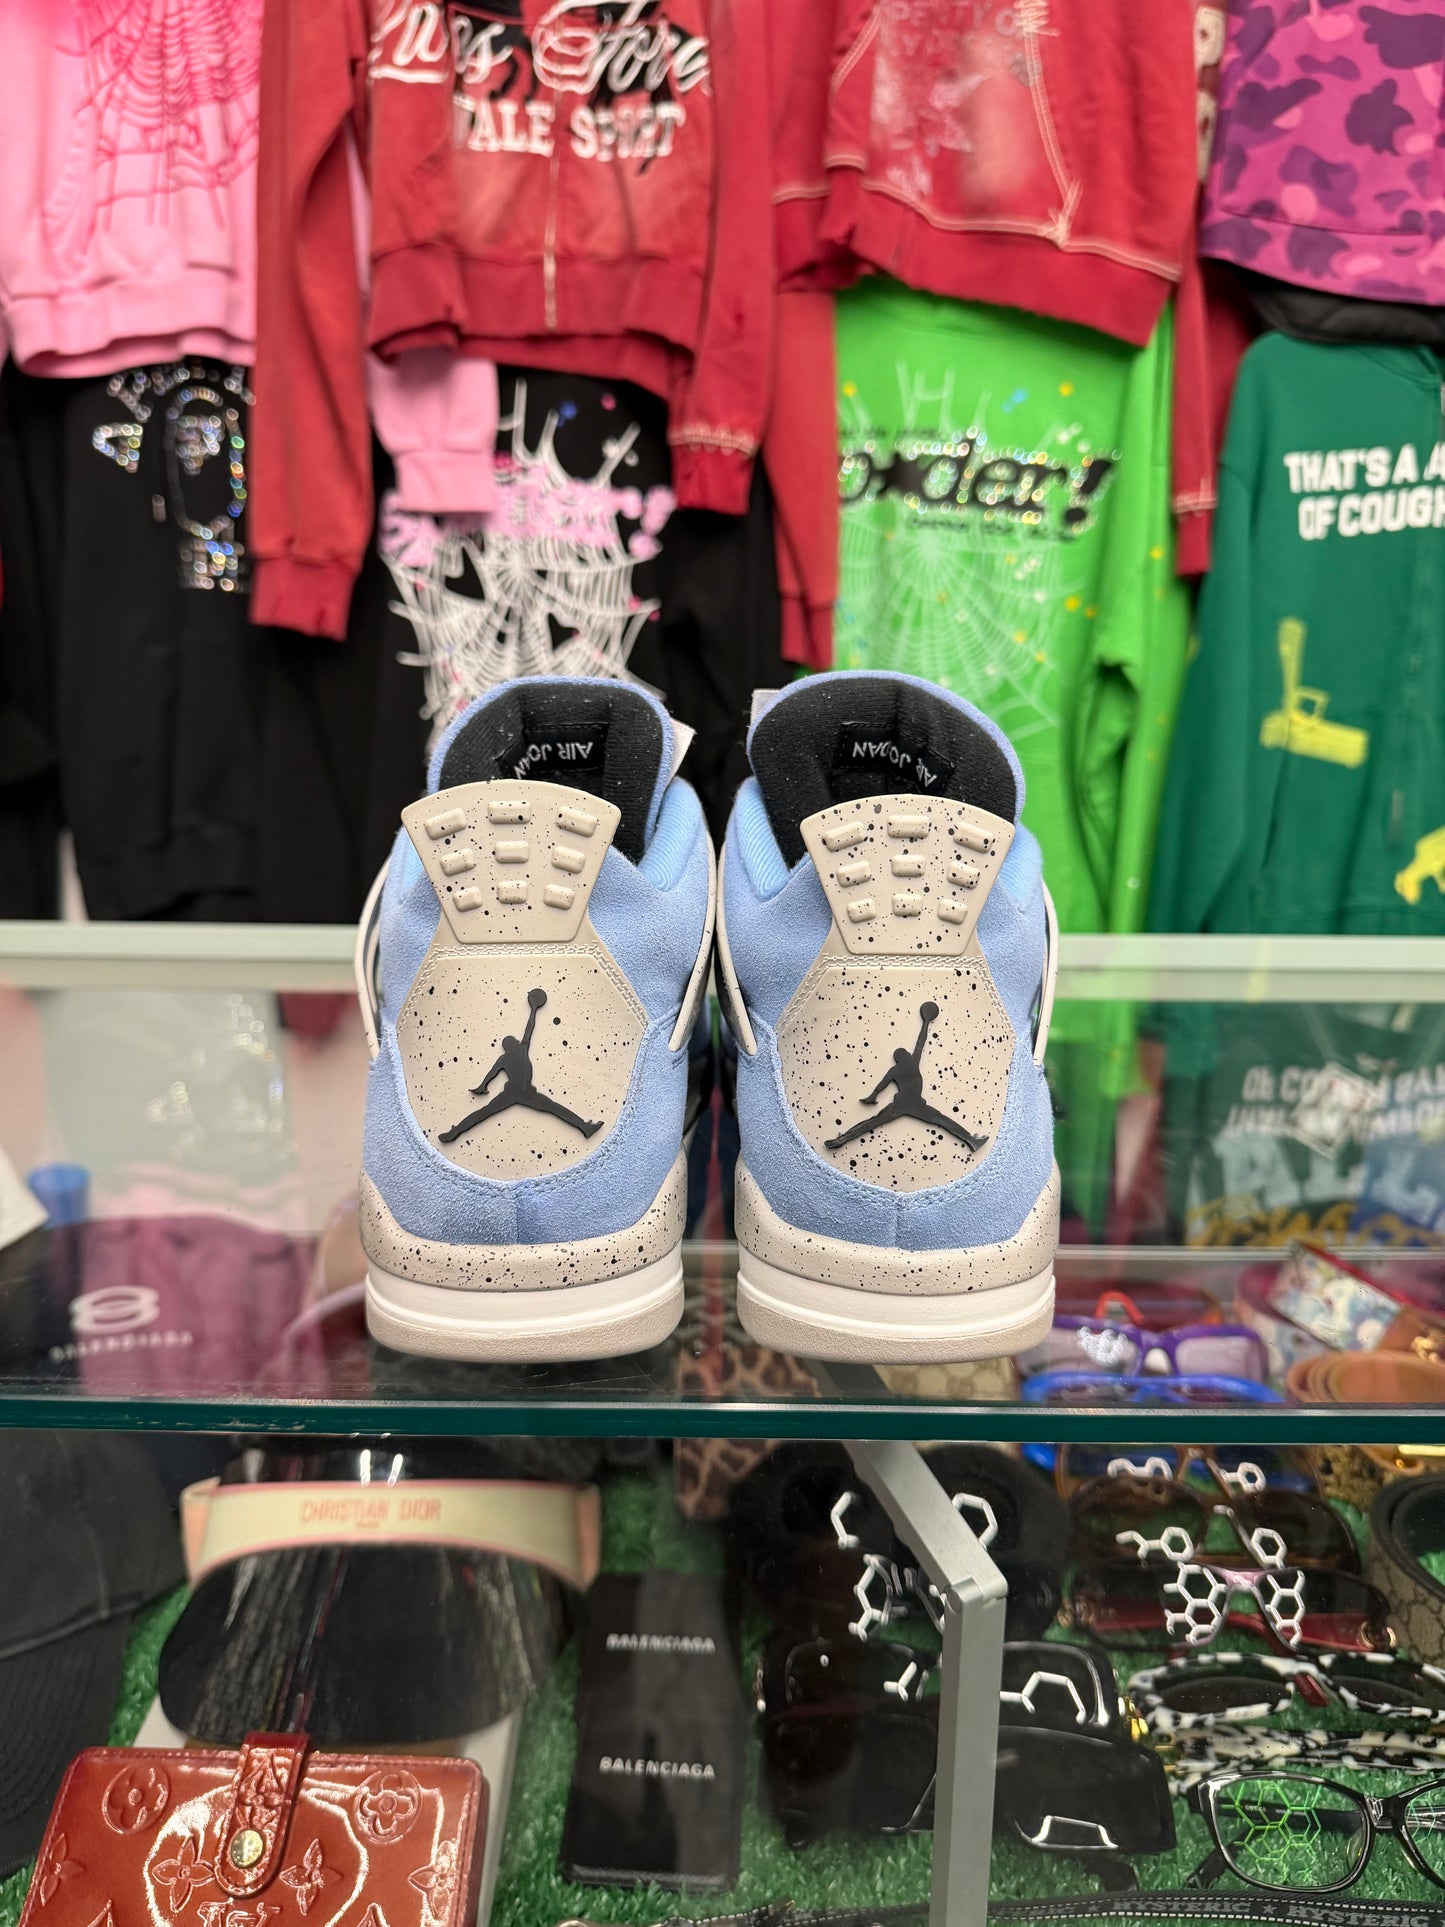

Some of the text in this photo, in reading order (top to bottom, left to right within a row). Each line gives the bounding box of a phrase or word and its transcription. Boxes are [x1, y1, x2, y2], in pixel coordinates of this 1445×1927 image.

[1283, 447, 1392, 494] THAT'S
[1391, 443, 1420, 485] A
[1298, 495, 1337, 541] OF
[556, 741, 594, 760] AIR
[301, 1498, 442, 1523] CHRISTIAN DIOR
[606, 1633, 717, 1655] BALENCIAGA
[599, 1755, 716, 1781] BALENCIAGA
[1112, 1900, 1251, 1914] HYSTERIC
[1286, 1904, 1430, 1927] HYSTERIC
